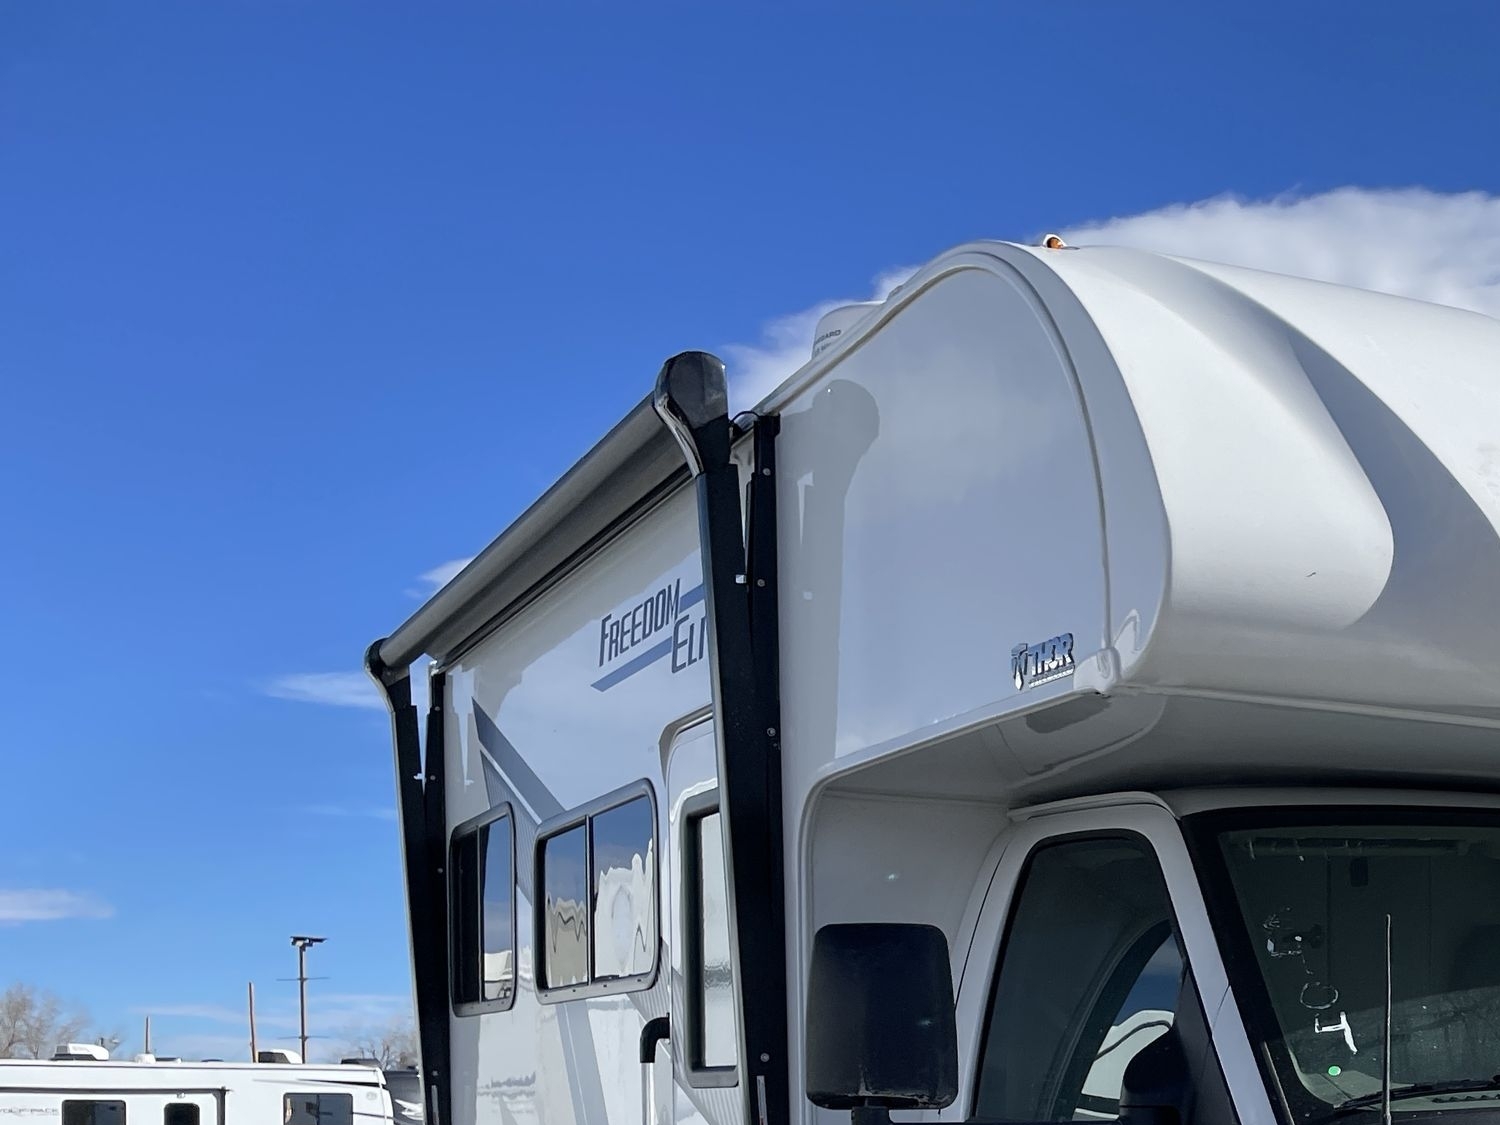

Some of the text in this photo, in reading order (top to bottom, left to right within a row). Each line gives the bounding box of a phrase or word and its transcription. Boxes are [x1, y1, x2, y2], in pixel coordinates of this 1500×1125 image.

[599, 578, 680, 668] FREEDOM
[671, 614, 706, 674] ELI
[1028, 632, 1075, 677] THOR
